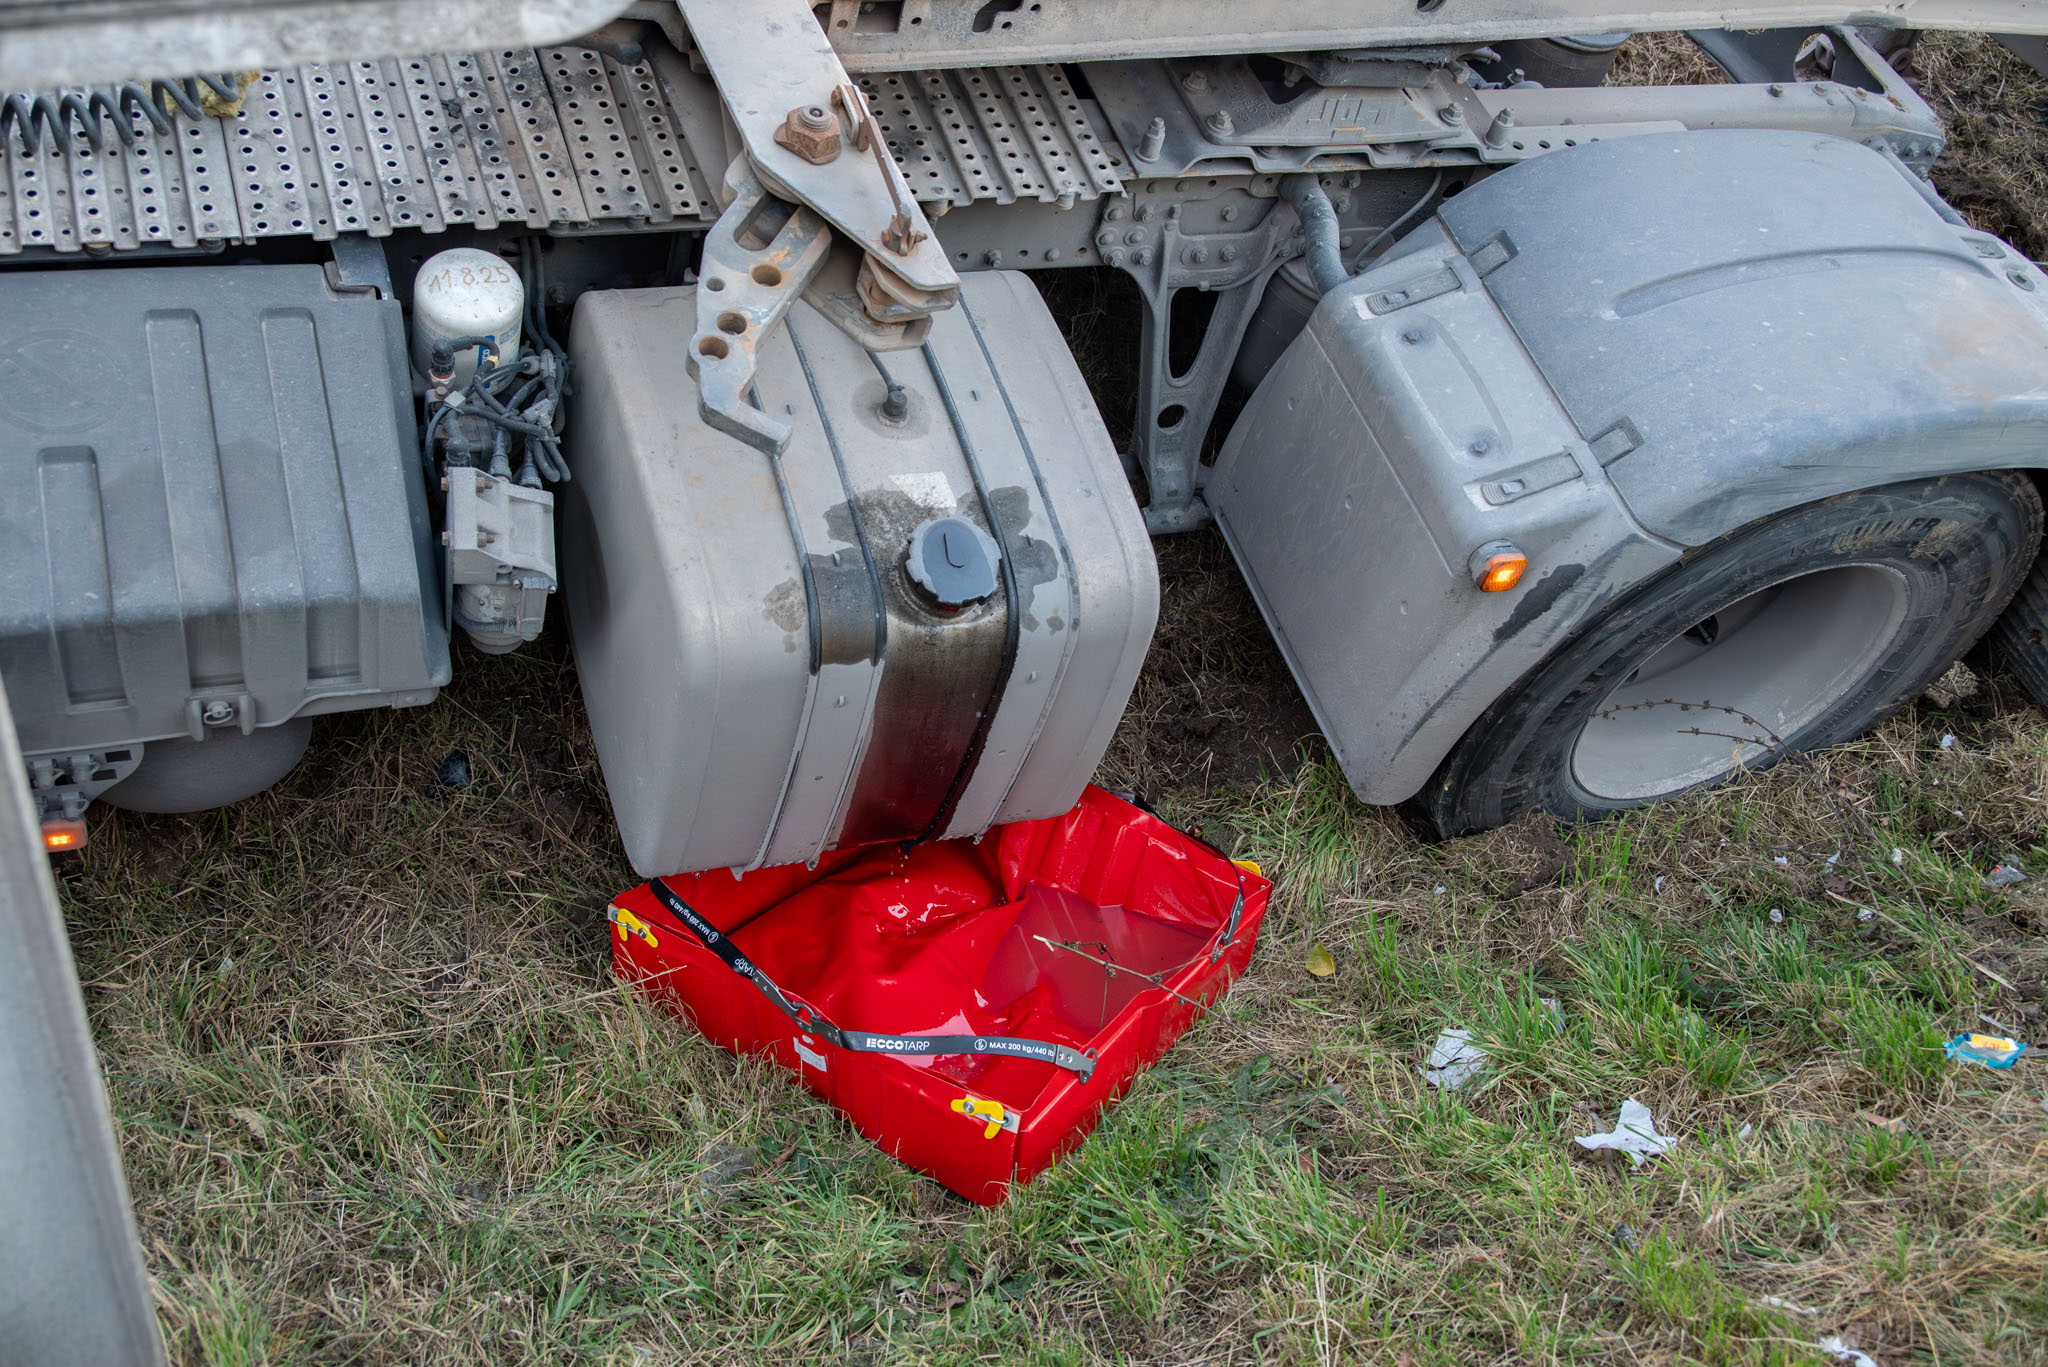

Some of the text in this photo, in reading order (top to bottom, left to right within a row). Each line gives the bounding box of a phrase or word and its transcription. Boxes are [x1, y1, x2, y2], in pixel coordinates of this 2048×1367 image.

[698, 923, 711, 936] MAX
[866, 1037, 930, 1051] ECCOTARP
[1008, 1043, 1021, 1051] 200
[1022, 1045, 1047, 1054] kg/440
[1047, 1049, 1055, 1057] lb
